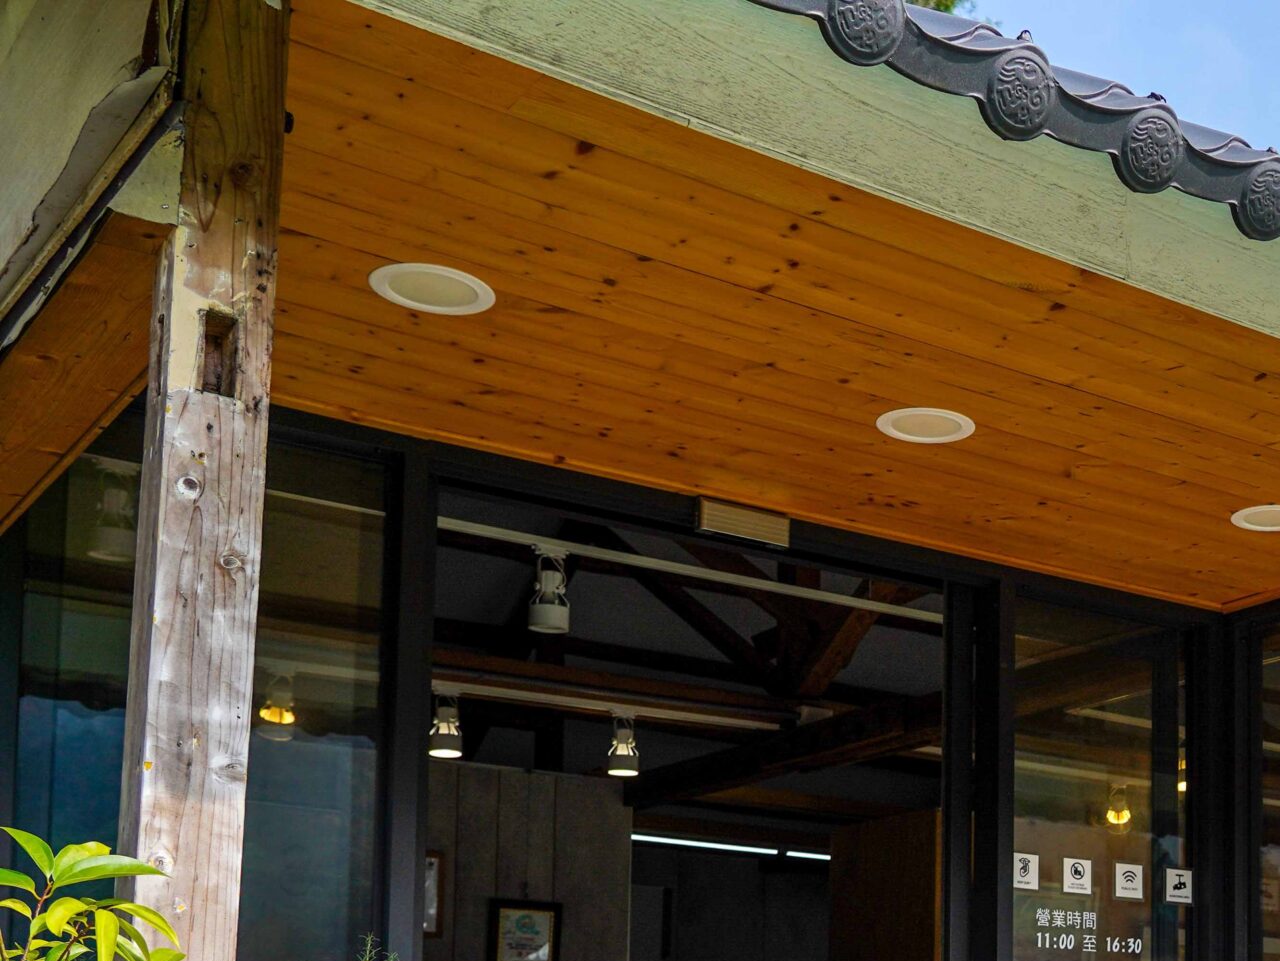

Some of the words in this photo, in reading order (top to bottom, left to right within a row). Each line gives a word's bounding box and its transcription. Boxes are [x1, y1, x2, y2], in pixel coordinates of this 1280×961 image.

[1036, 908, 1097, 930] 營業時間
[1036, 932, 1075, 949] 11:00
[1082, 934, 1097, 952] 至
[1105, 936, 1142, 954] 16:30
